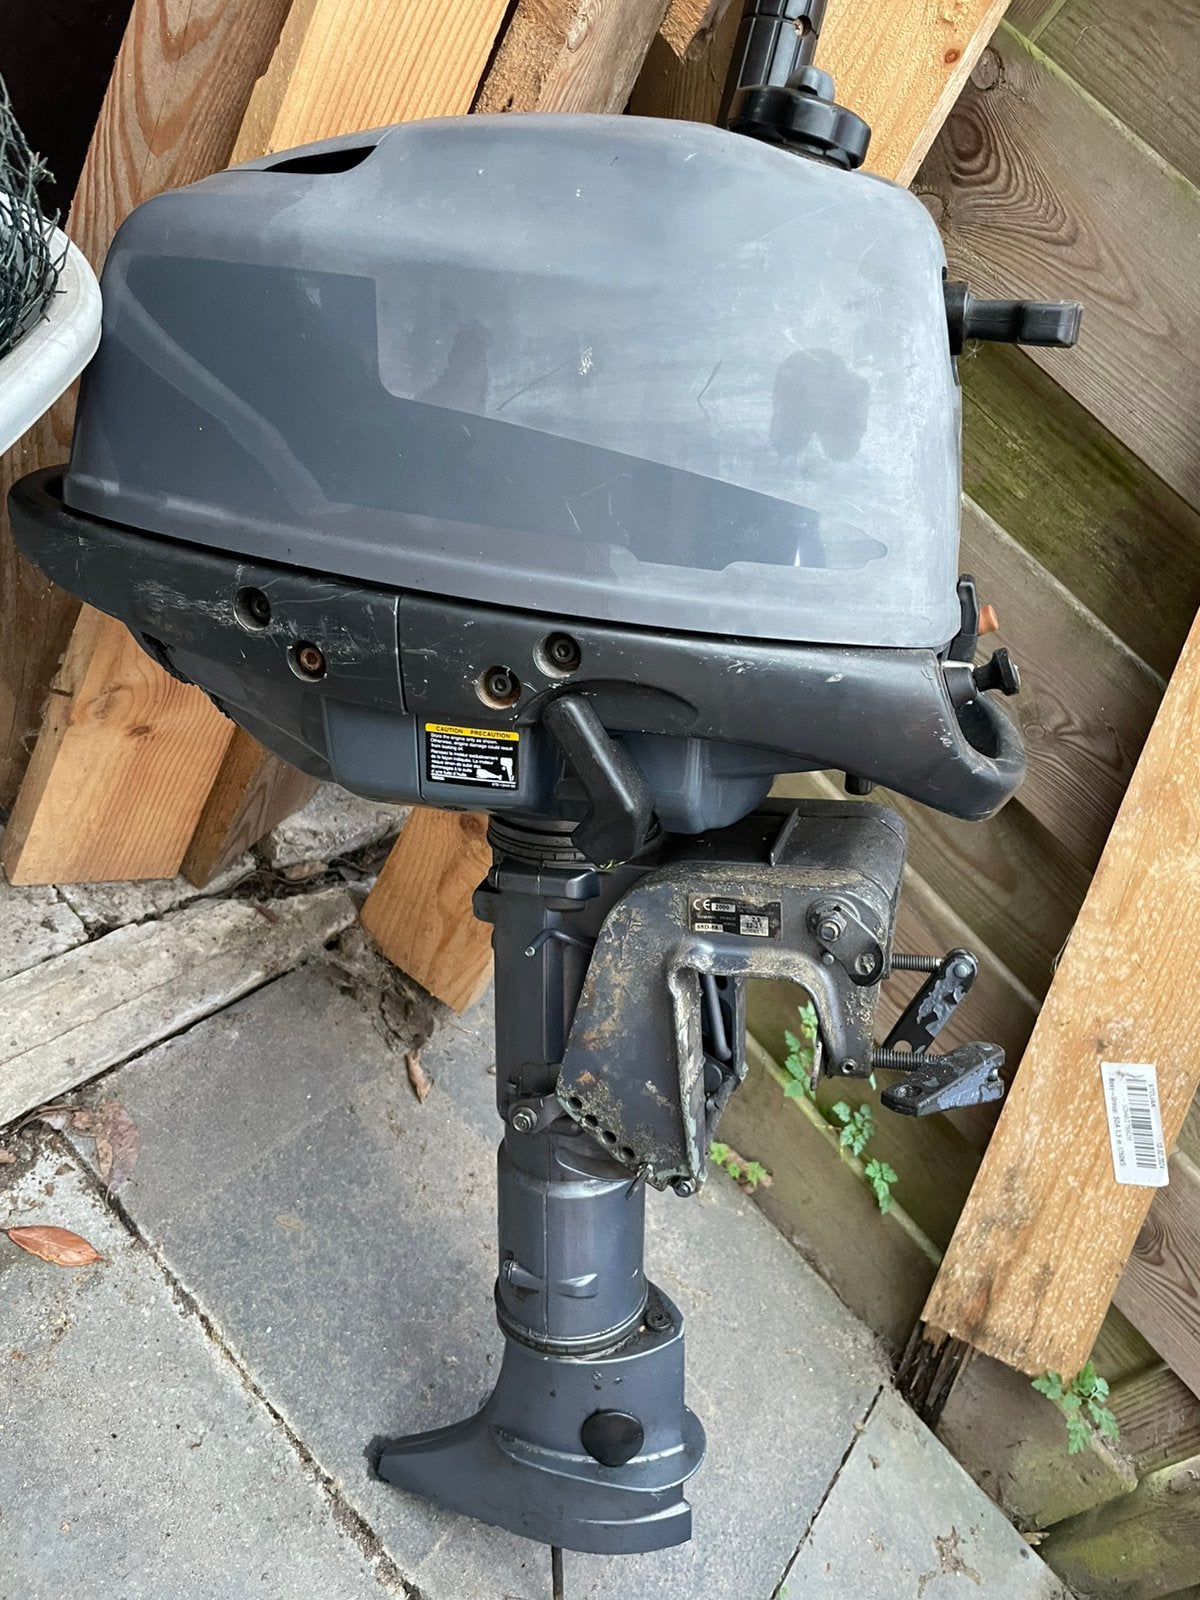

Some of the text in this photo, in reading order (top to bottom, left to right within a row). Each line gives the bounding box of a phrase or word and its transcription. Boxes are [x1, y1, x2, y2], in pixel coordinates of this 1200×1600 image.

[435, 725, 512, 739] CAUTION PRECAUTION
[430, 737, 453, 745] Otherwise,
